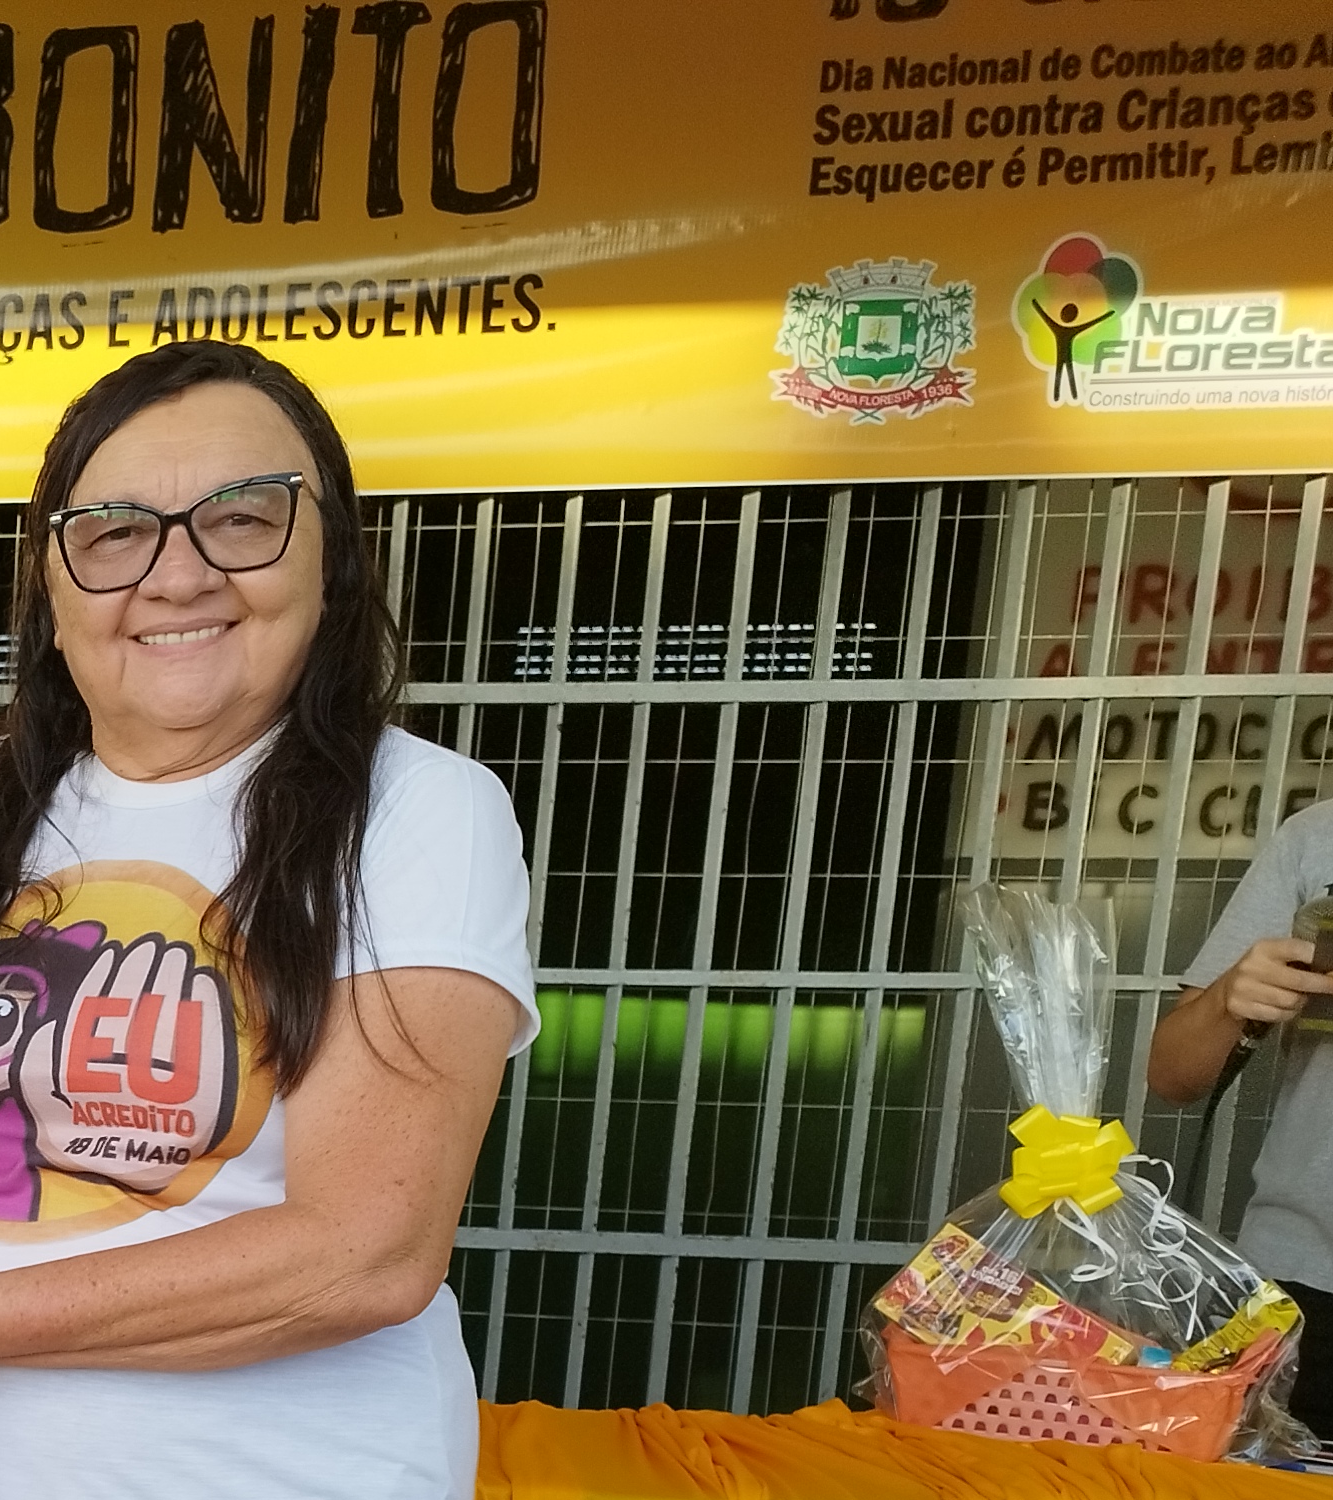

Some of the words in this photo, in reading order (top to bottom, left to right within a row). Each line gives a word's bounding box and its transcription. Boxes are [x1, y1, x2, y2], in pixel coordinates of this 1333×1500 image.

[820, 58, 874, 93] Dia
[883, 50, 1032, 91] Nacional
[1040, 46, 1082, 82] de
[1090, 38, 1246, 79] Combate
[1254, 41, 1297, 72] ao
[813, 98, 955, 146] Sexual
[965, 94, 1105, 140] contra
[1117, 86, 1316, 136] Crianças
[809, 156, 995, 203] Esquecer
[1002, 145, 1026, 188] é
[1037, 139, 1216, 187] Permitir,
[107, 289, 134, 349] E
[149, 273, 557, 349] ADOLESCENTES.
[829, 389, 858, 406] NOVA
[859, 388, 915, 407] FLORESTA
[1089, 388, 1191, 407] Construindo
[1196, 390, 1232, 404] uma
[1238, 389, 1280, 404] nova
[66, 992, 203, 1105] EU
[72, 1101, 196, 1138] ACREDITO
[64, 1137, 94, 1155] 18
[90, 1136, 121, 1159] DE
[125, 1138, 192, 1166] MAIO
